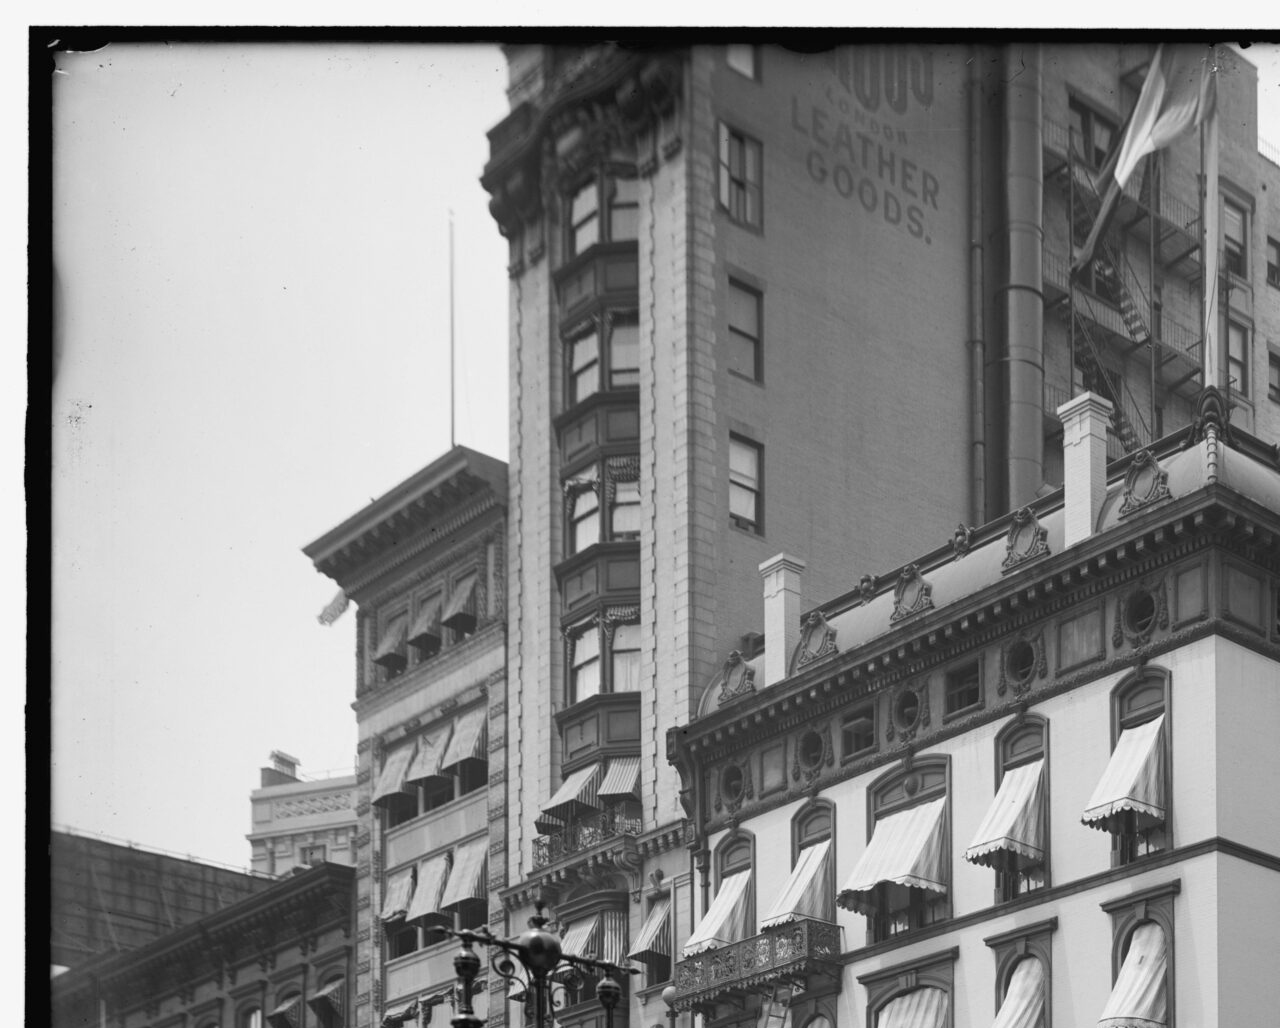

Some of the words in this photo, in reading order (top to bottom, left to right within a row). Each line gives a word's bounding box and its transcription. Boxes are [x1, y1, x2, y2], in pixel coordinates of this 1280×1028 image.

[791, 94, 939, 210] LEATHER
[825, 85, 907, 145] LONDON
[806, 149, 932, 245] GOODS.
